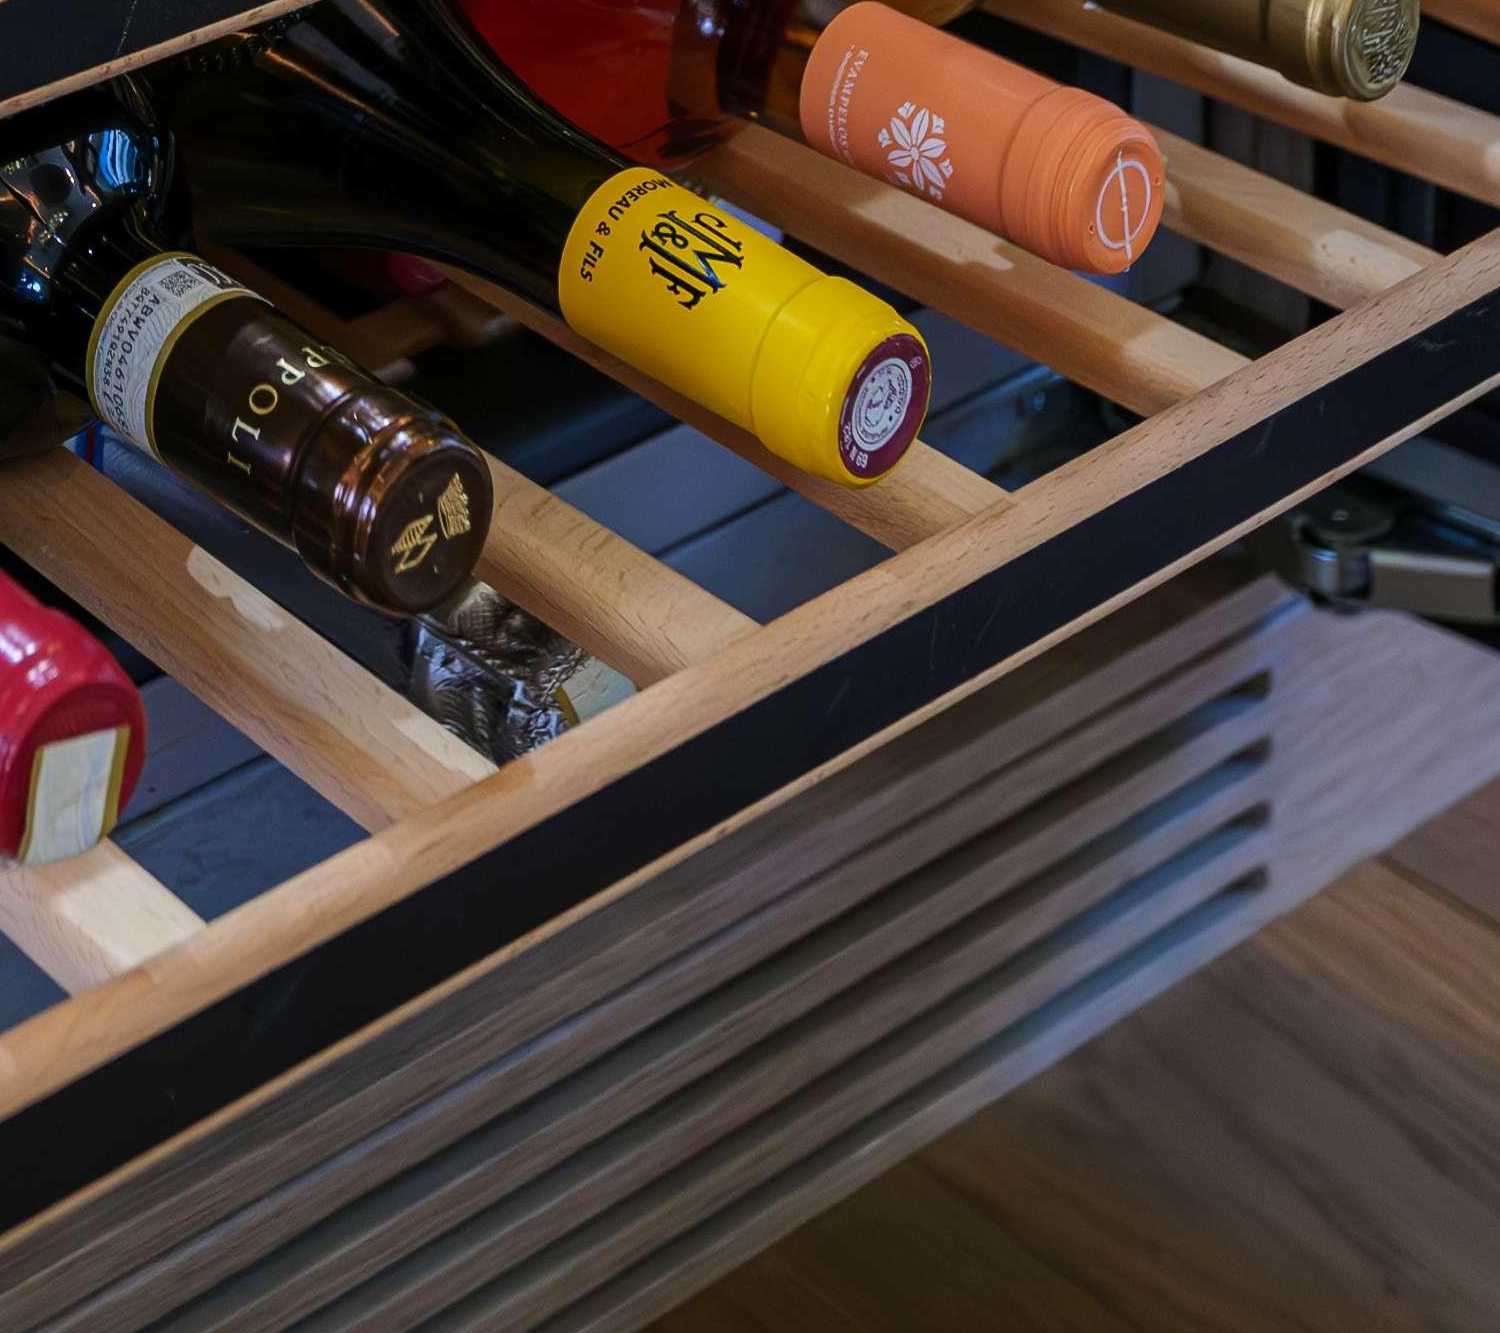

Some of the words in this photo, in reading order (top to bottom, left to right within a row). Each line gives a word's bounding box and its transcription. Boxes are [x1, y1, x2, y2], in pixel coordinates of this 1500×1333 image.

[608, 179, 672, 221] MOREAU
[595, 220, 611, 236] &
[580, 240, 604, 282] FILS
[227, 346, 331, 476] PPOLI
